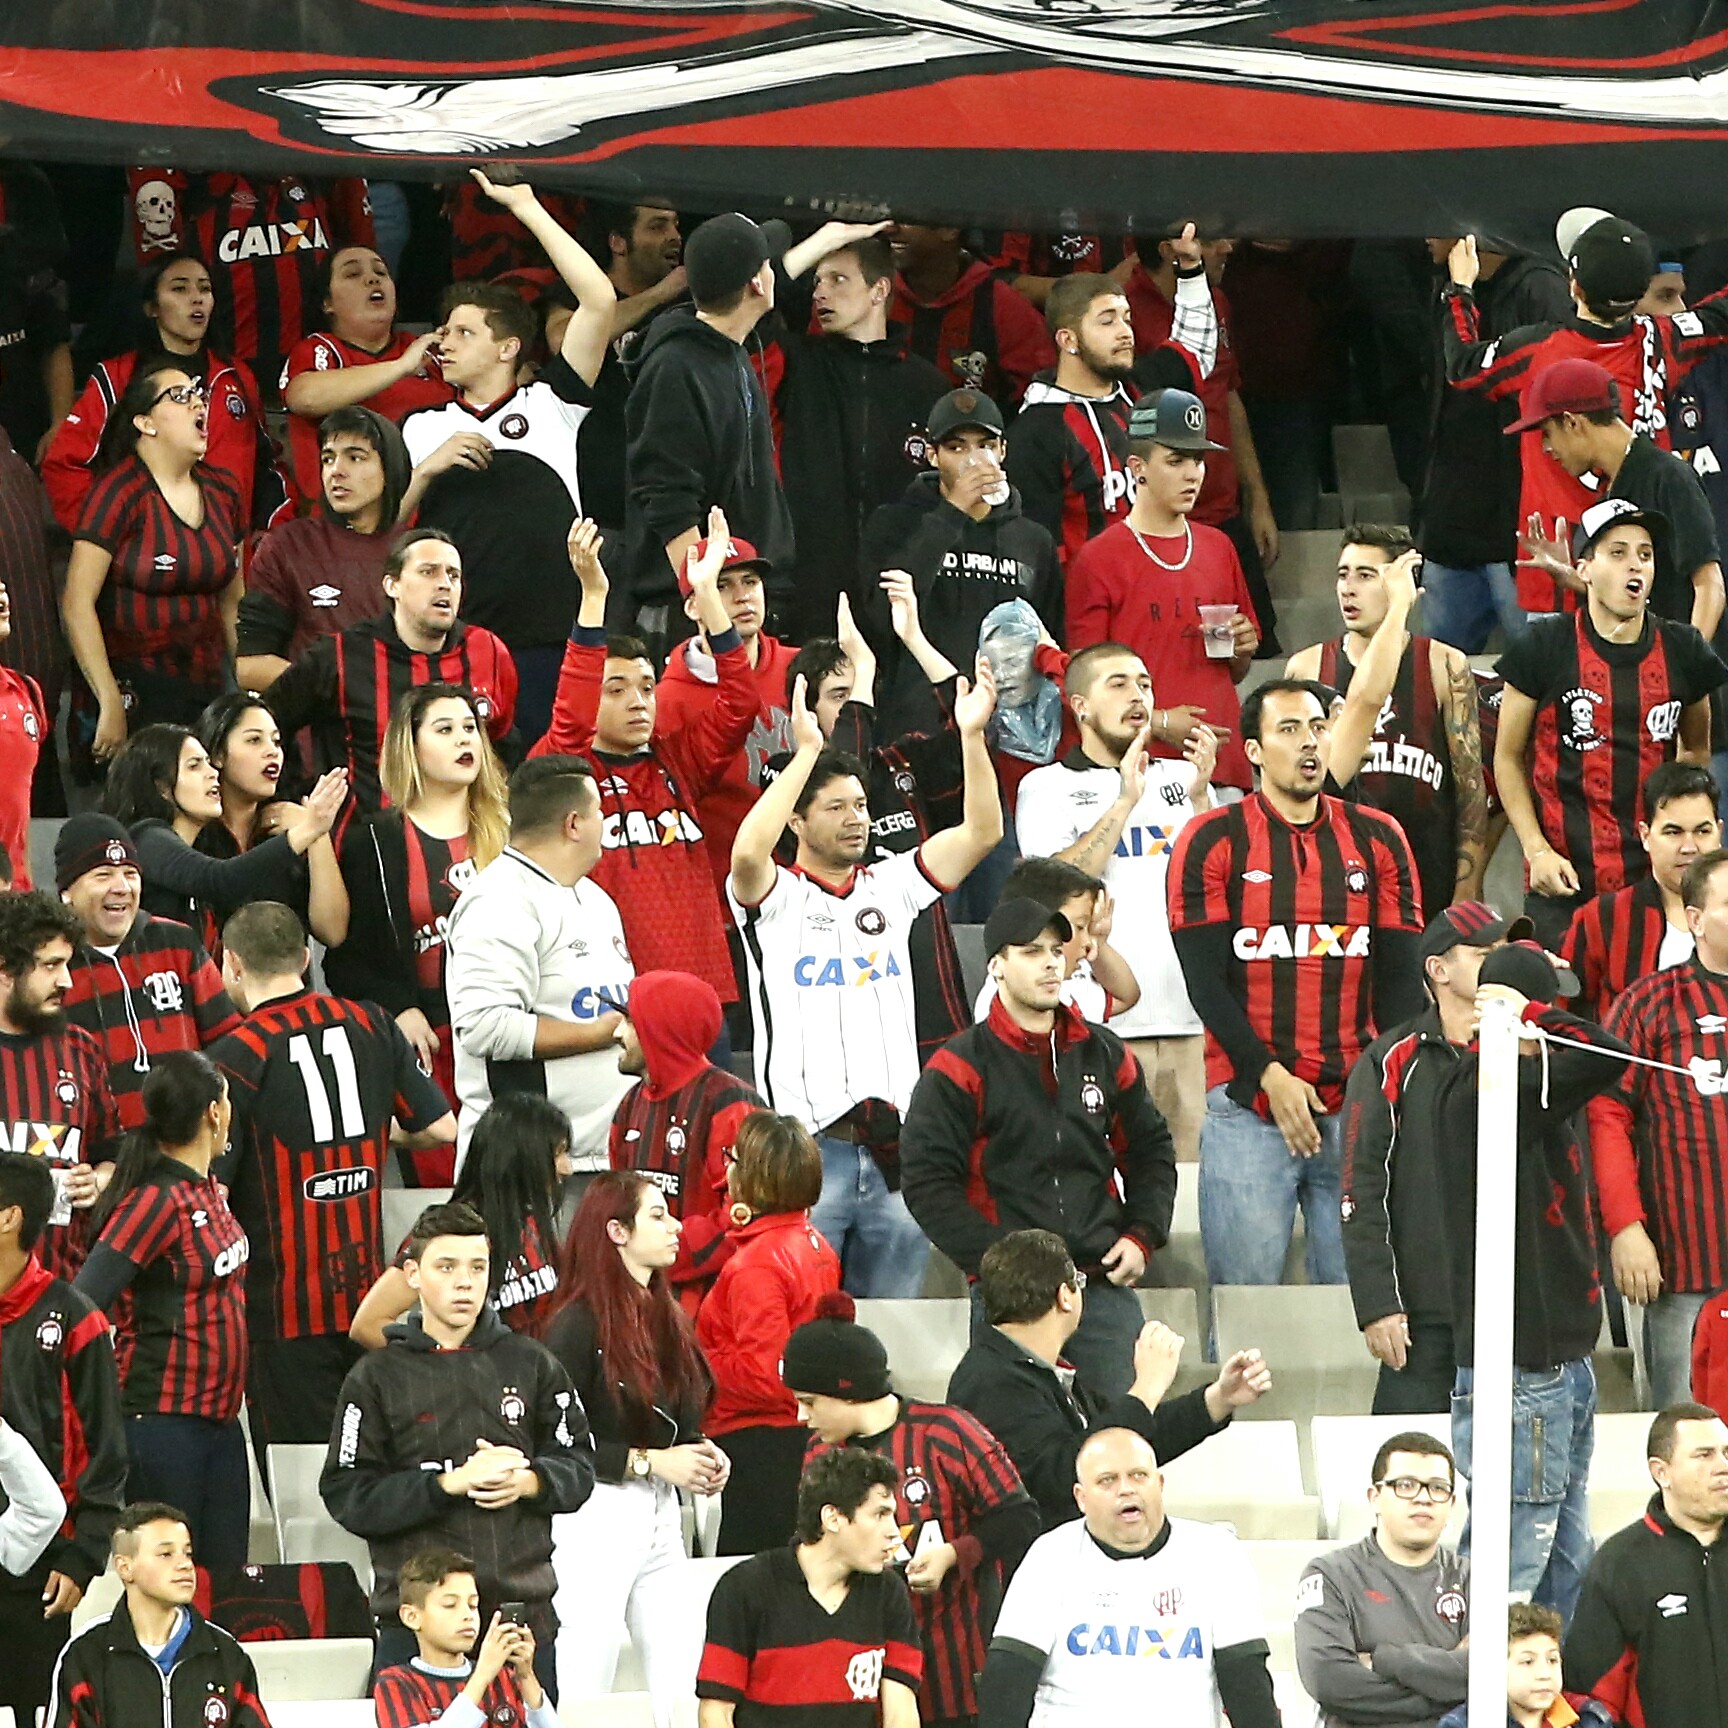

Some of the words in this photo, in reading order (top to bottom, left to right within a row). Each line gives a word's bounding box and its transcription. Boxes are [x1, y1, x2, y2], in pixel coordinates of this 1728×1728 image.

[219, 216, 331, 265] CAIXA
[601, 810, 704, 851] CAIXA
[1232, 924, 1370, 962] CAIXA
[287, 1025, 368, 1143] 11
[337, 1170, 369, 1191] TIM
[1067, 1624, 1204, 1661] CAIXA
